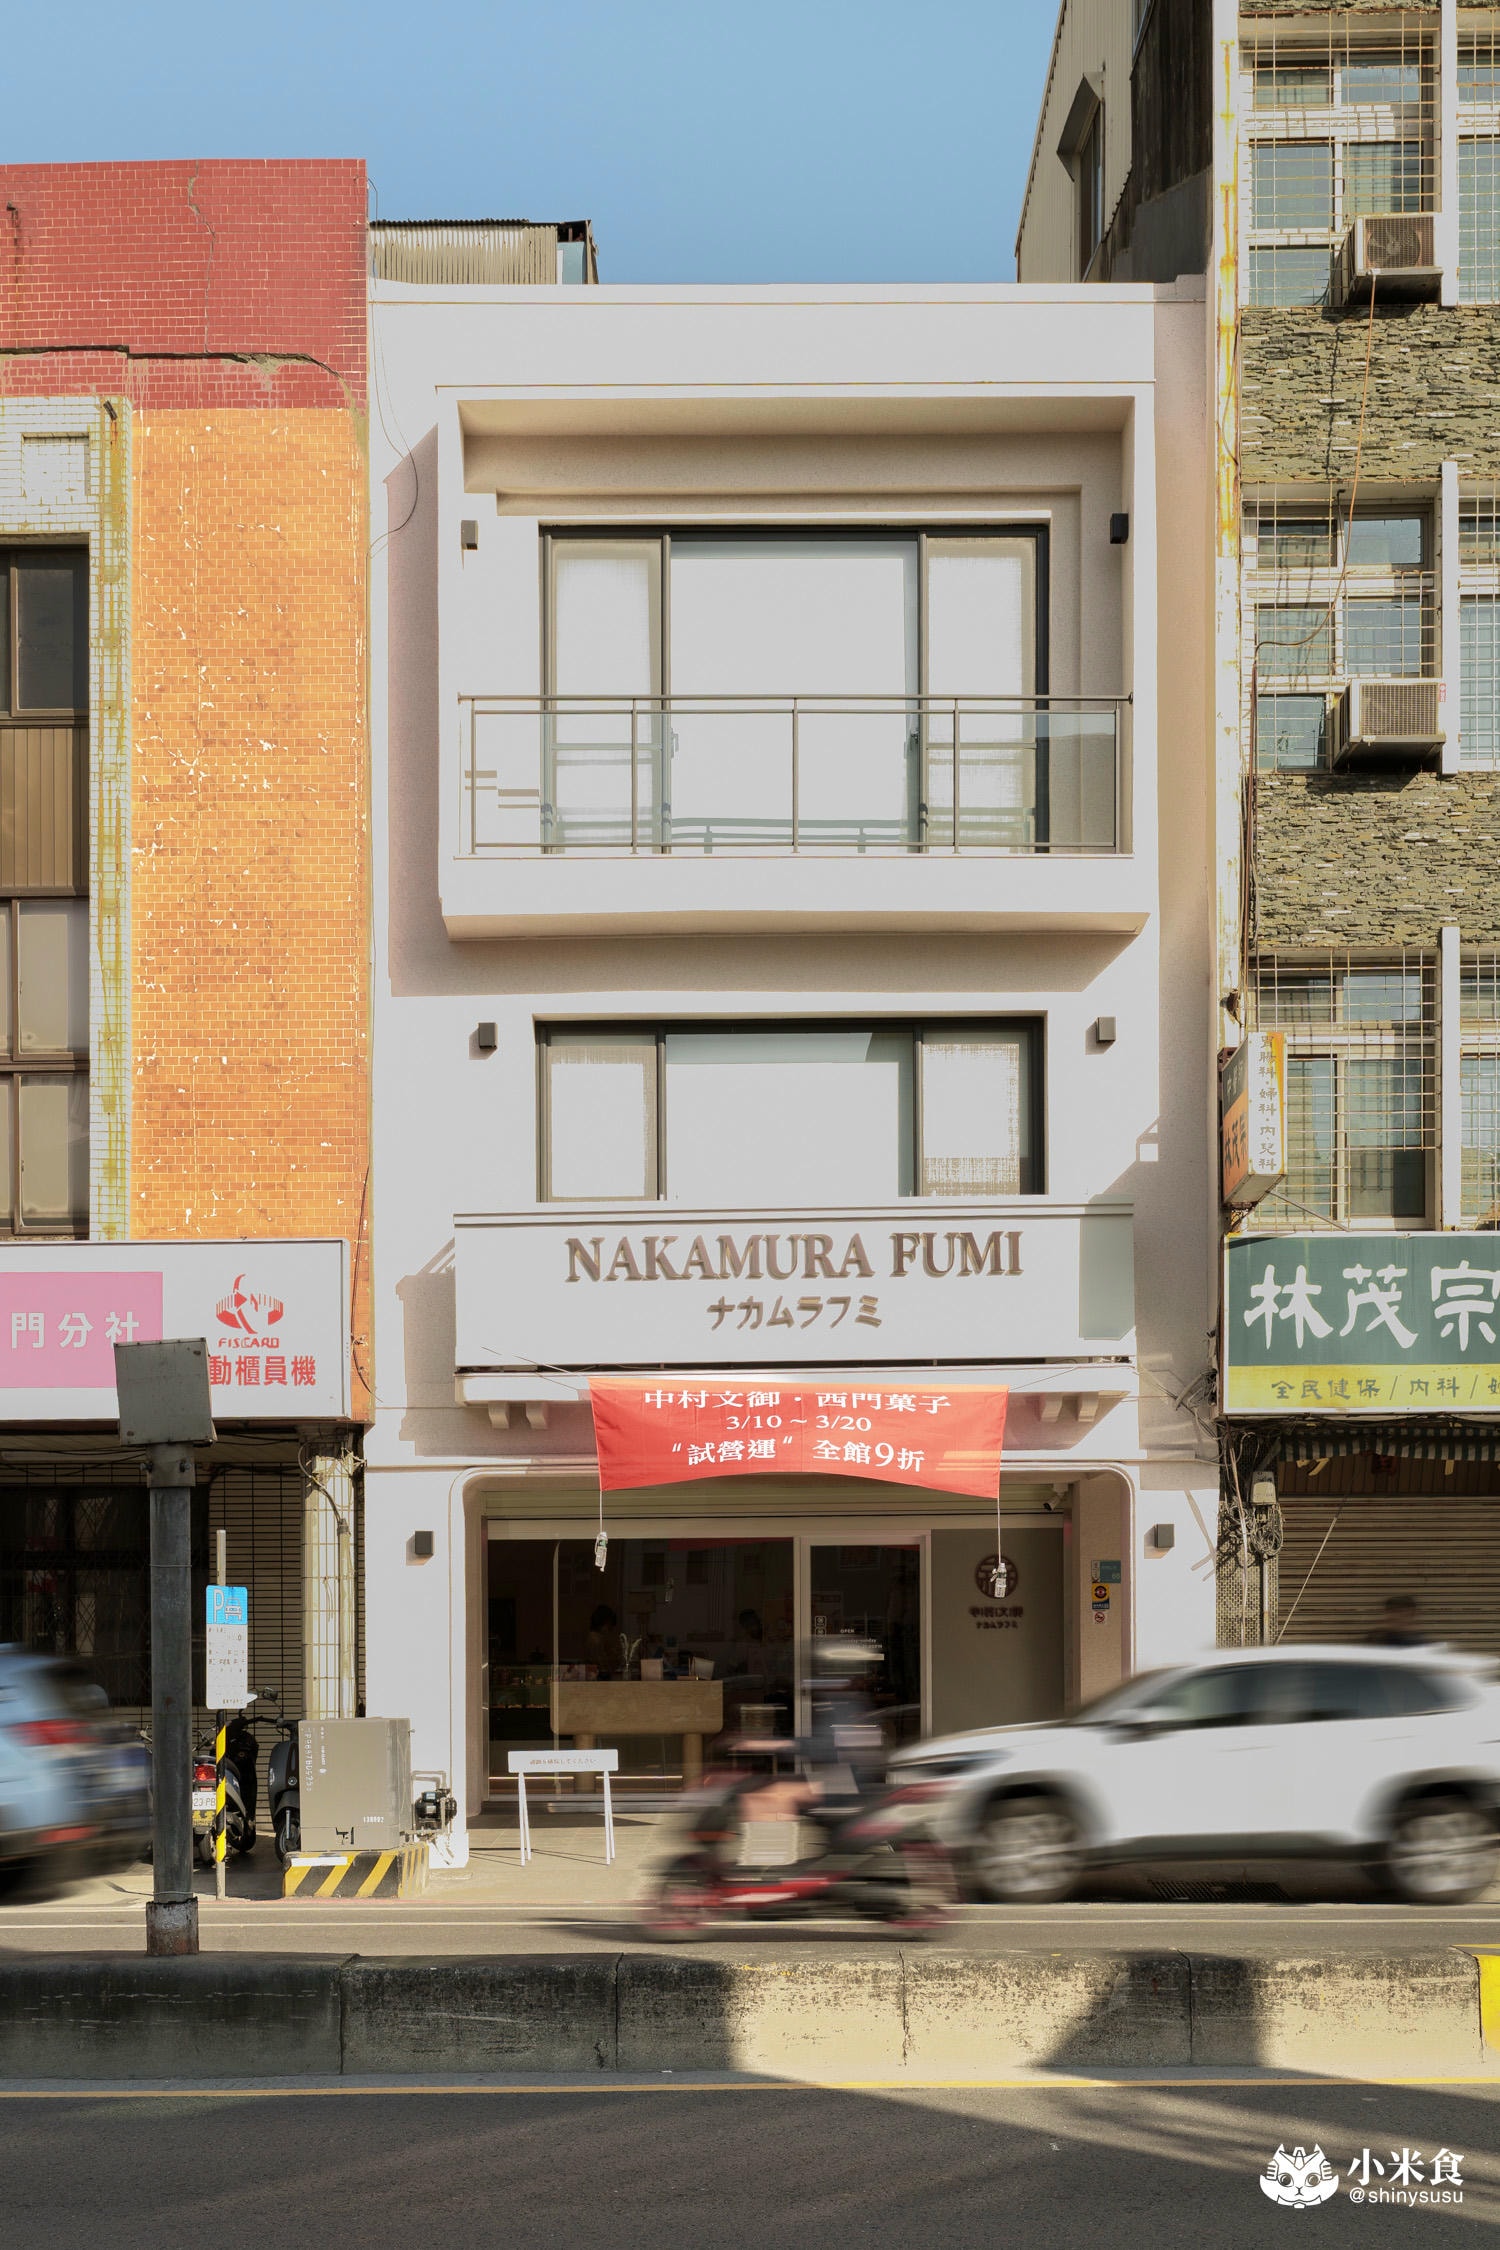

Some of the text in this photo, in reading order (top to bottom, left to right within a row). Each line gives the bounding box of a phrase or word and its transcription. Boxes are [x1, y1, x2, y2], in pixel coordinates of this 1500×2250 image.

[565, 1231, 1024, 1282] NAKAMURA FUMI
[706, 1295, 882, 1331] ナカムラフミ
[1243, 1259, 1500, 1352] 林茂宗
[11, 1311, 140, 1349] 門分社
[218, 1337, 279, 1348] FISCARD
[726, 1415, 782, 1430] 3/10
[815, 1415, 872, 1432] 3/20
[812, 1439, 925, 1472] 全館9折
